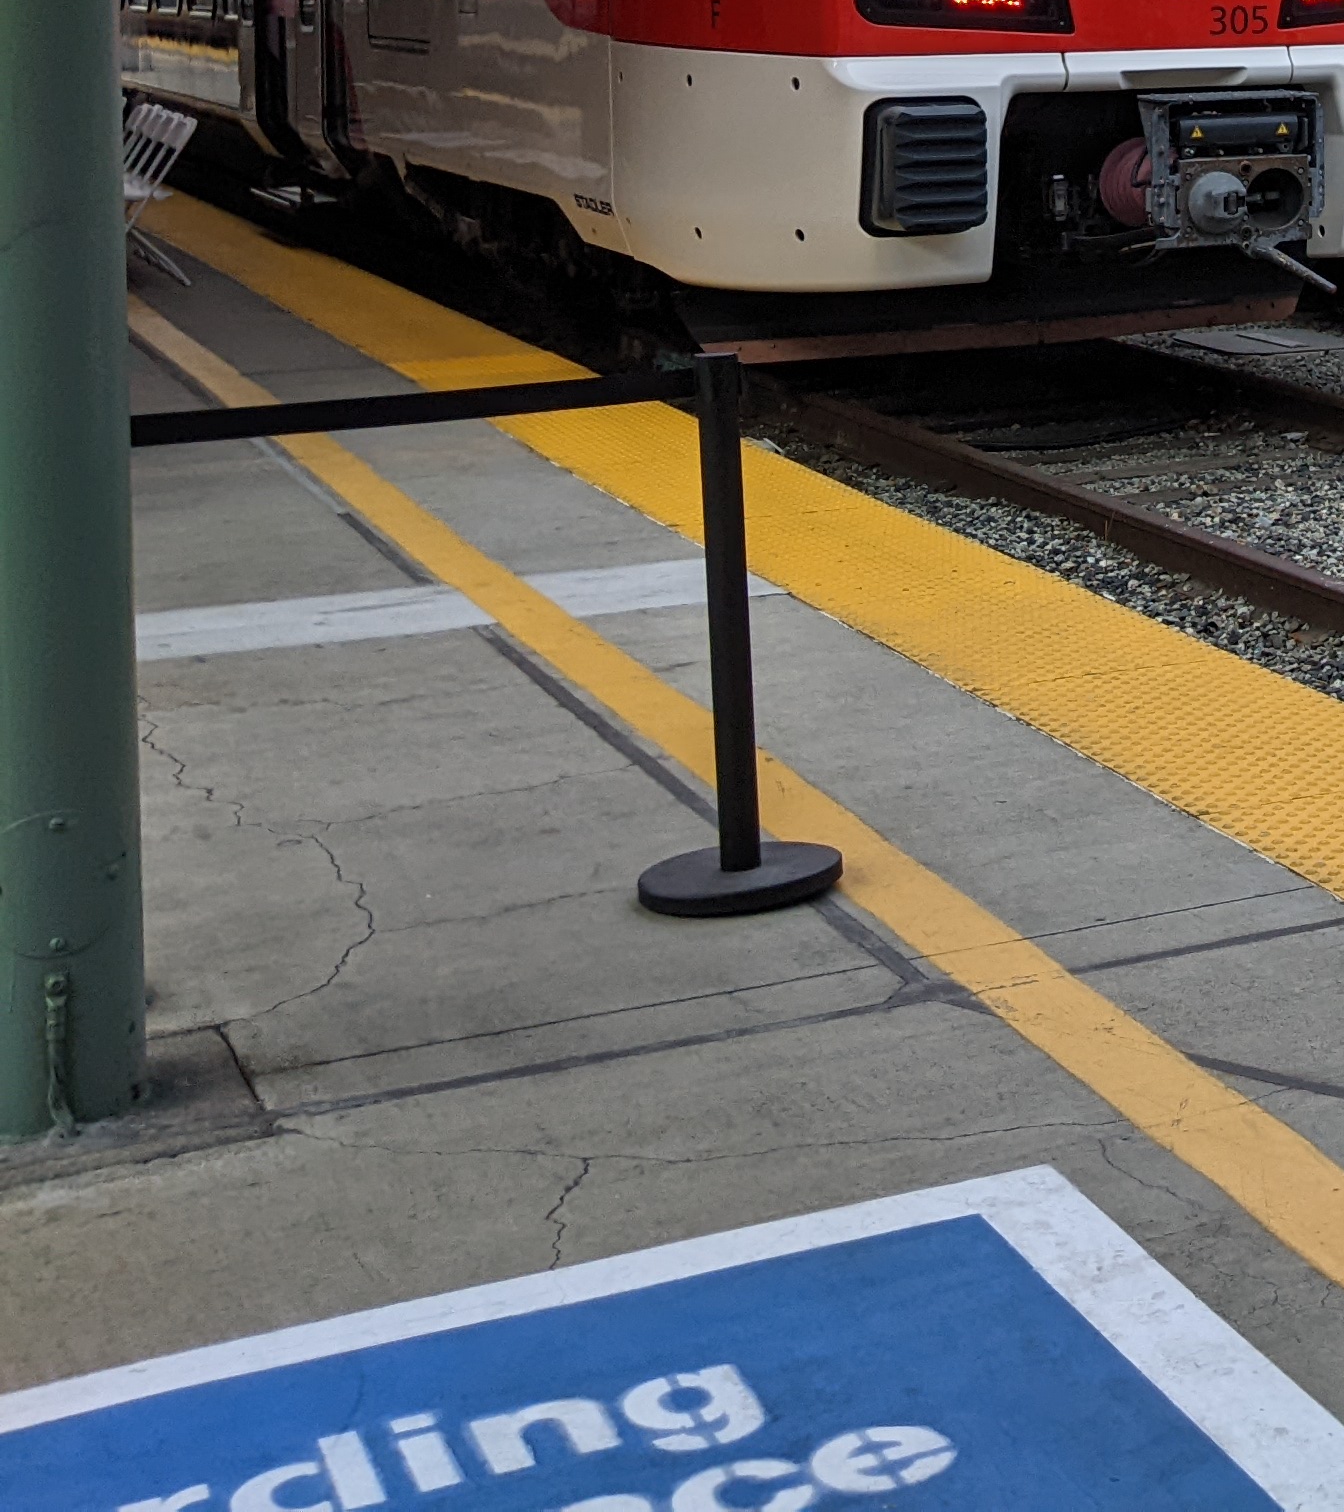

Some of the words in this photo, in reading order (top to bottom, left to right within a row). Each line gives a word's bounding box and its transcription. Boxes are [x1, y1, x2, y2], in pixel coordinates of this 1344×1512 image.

[711, 0, 720, 29] F
[1210, 5, 1268, 35] 305
[574, 194, 614, 216] STADLER
[560, 1425, 956, 1512] ce
